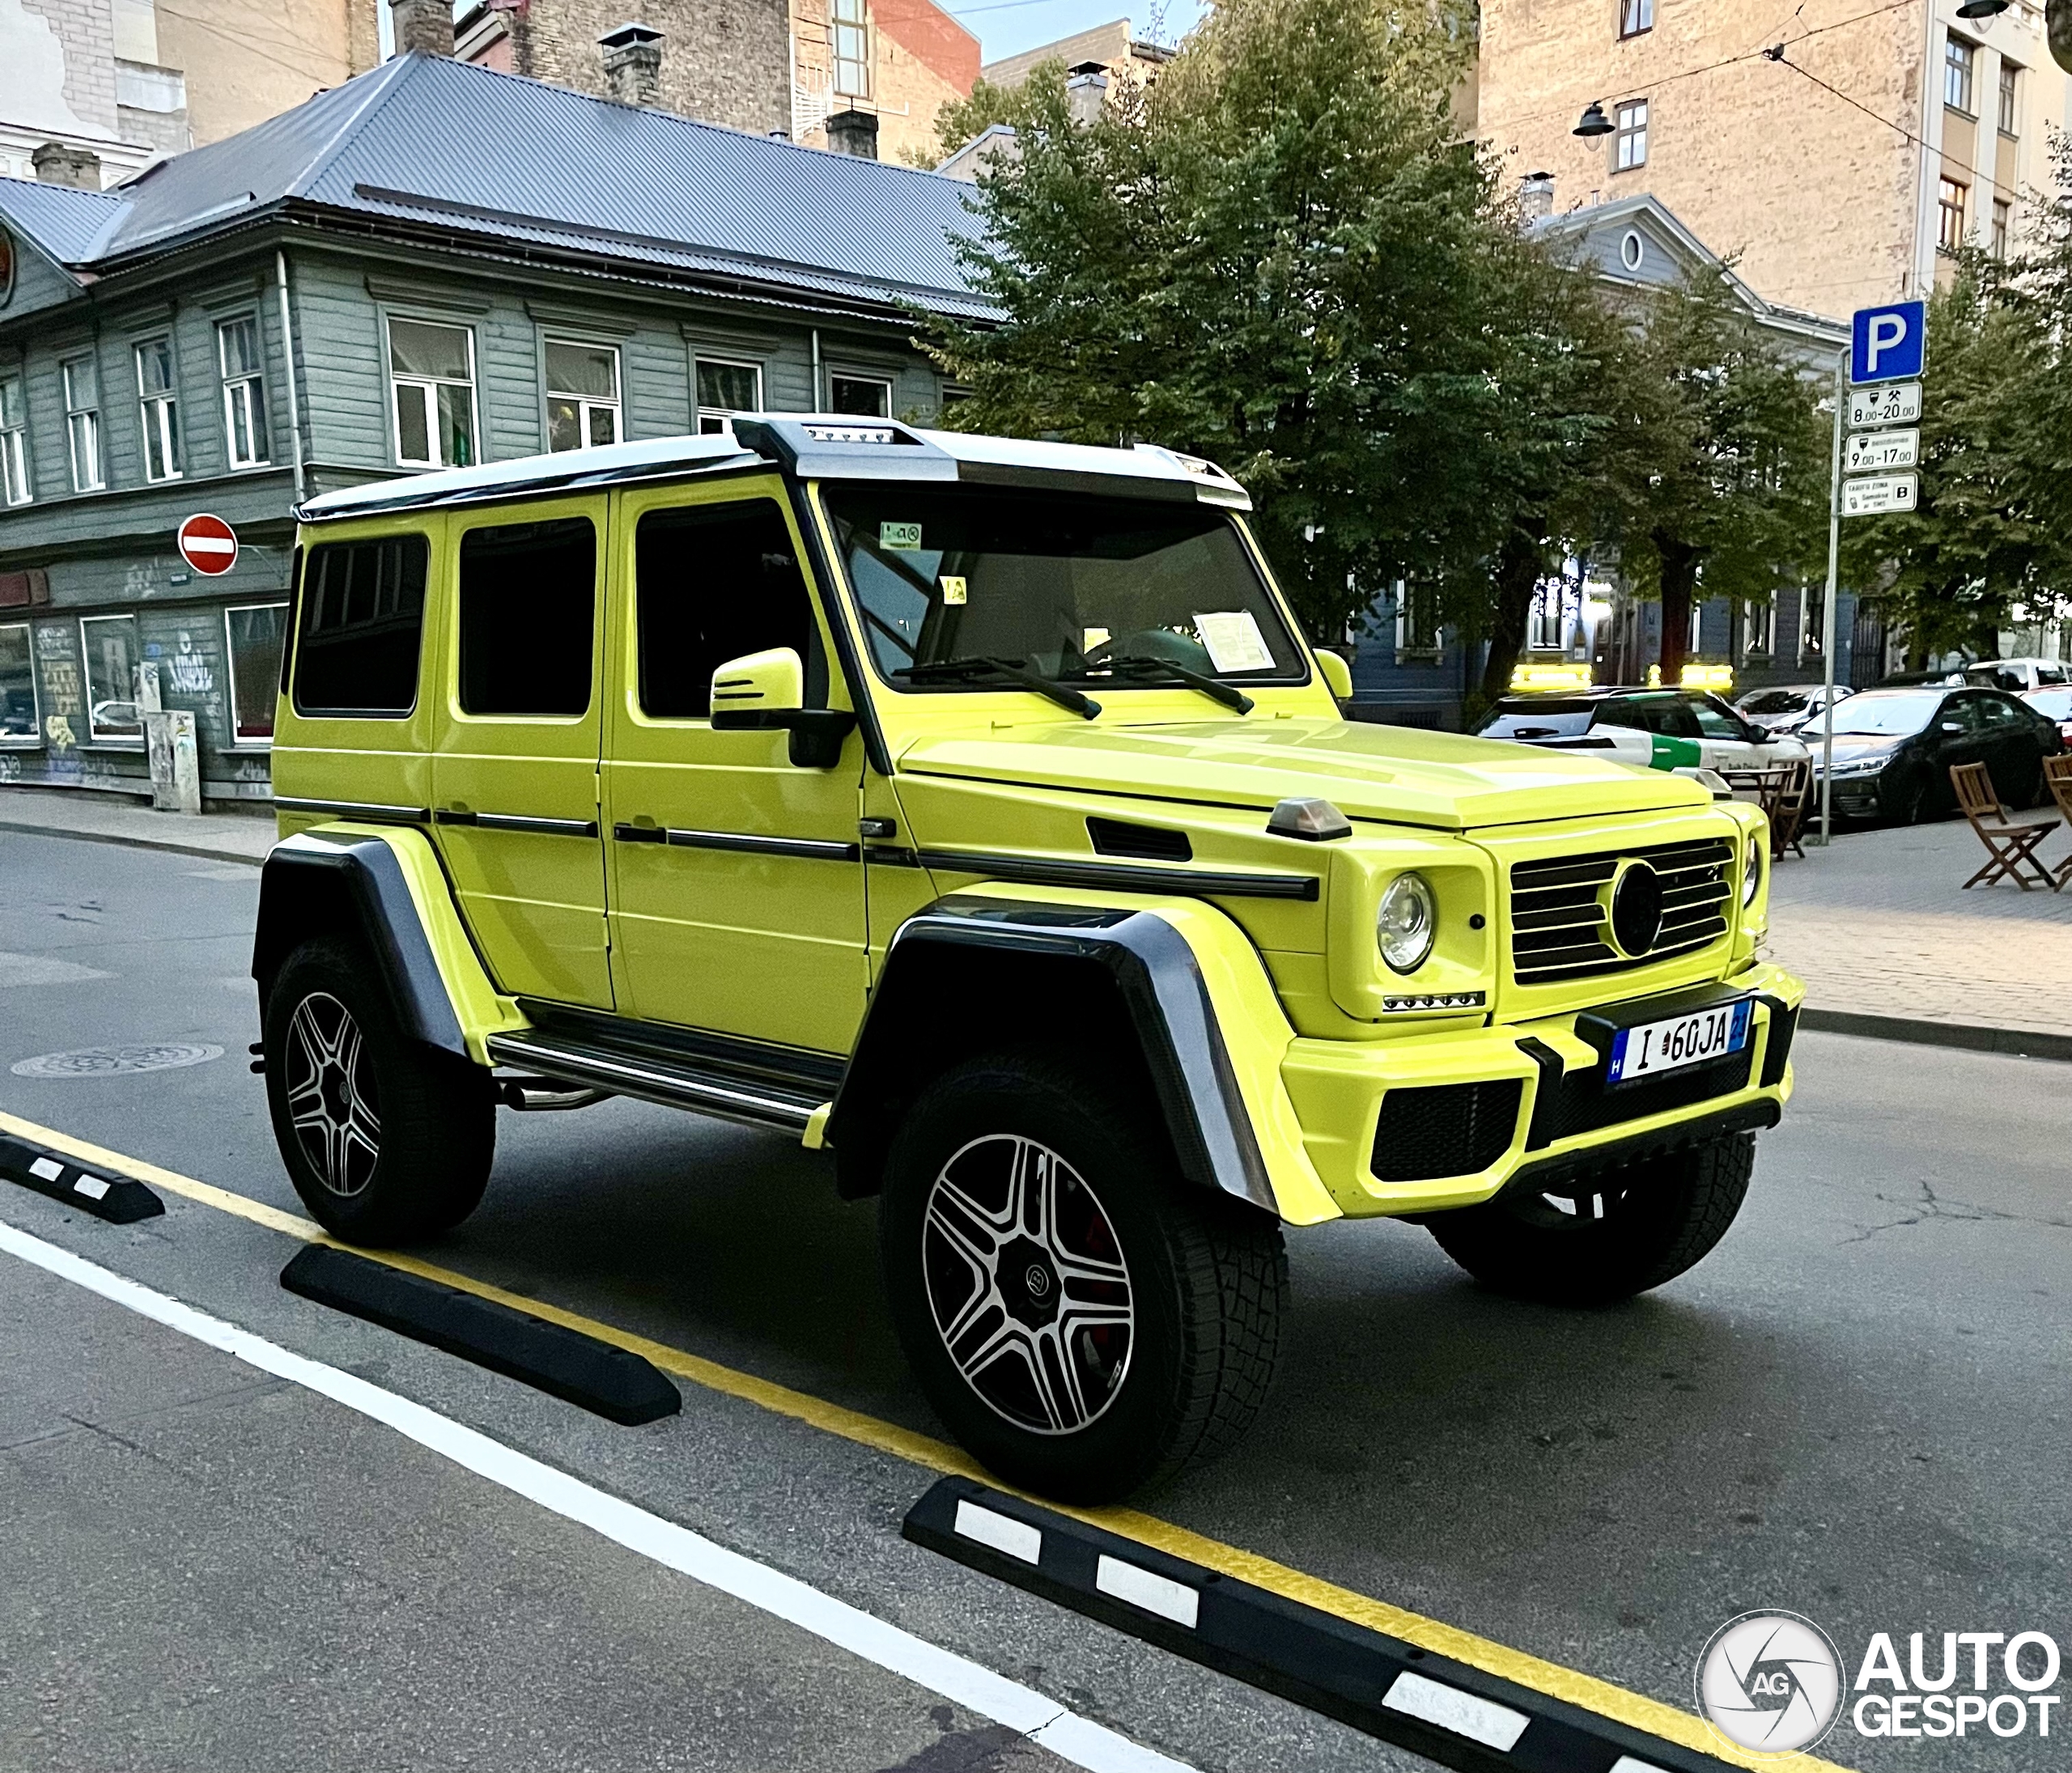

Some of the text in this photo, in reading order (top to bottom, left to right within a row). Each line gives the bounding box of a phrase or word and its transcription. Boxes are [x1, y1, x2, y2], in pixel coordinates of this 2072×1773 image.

[1866, 313, 1907, 373] P
[1896, 486, 1908, 498] B
[1611, 1059, 1621, 1075] H
